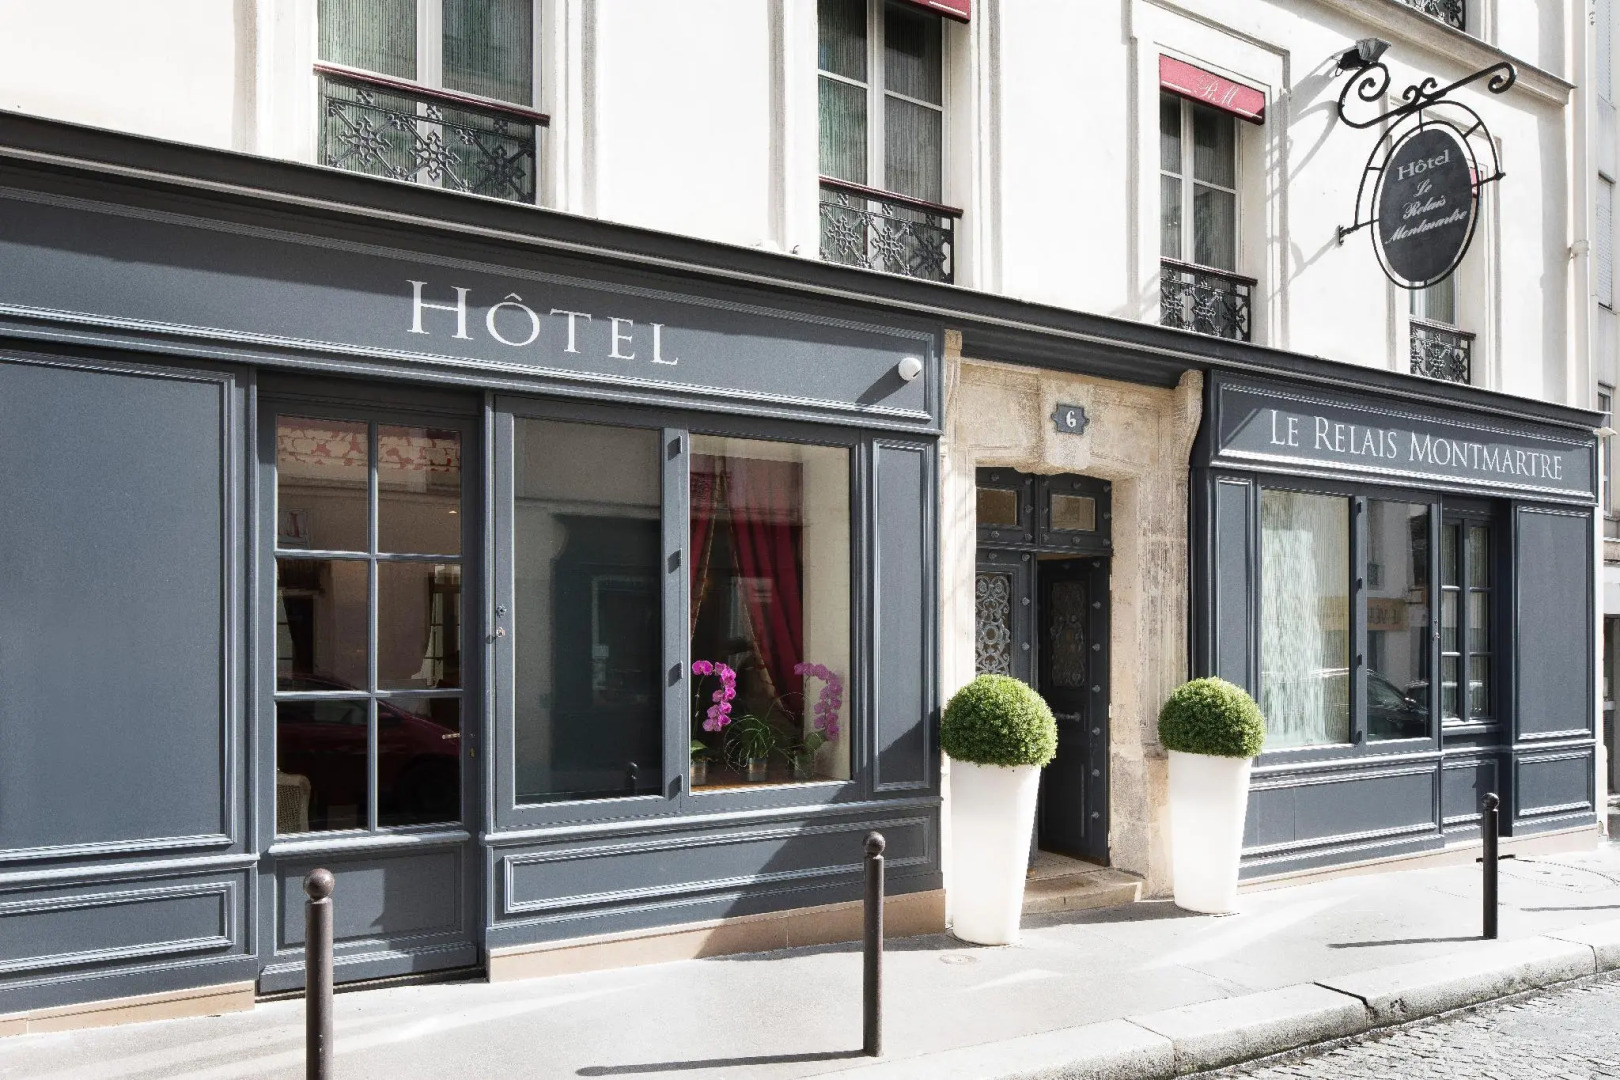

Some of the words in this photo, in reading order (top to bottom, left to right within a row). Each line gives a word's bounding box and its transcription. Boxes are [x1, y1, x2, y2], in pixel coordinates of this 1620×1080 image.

[1397, 149, 1450, 181] Hôtel
[1413, 179, 1433, 198] Le
[1402, 195, 1446, 220] Relais
[1384, 208, 1468, 245] Montmartre
[406, 279, 679, 366] HÔTEL
[1065, 410, 1077, 428] 6
[1270, 409, 1299, 447] LE
[1313, 415, 1397, 459] RELAIS
[1408, 430, 1563, 480] MONTMARTRE
